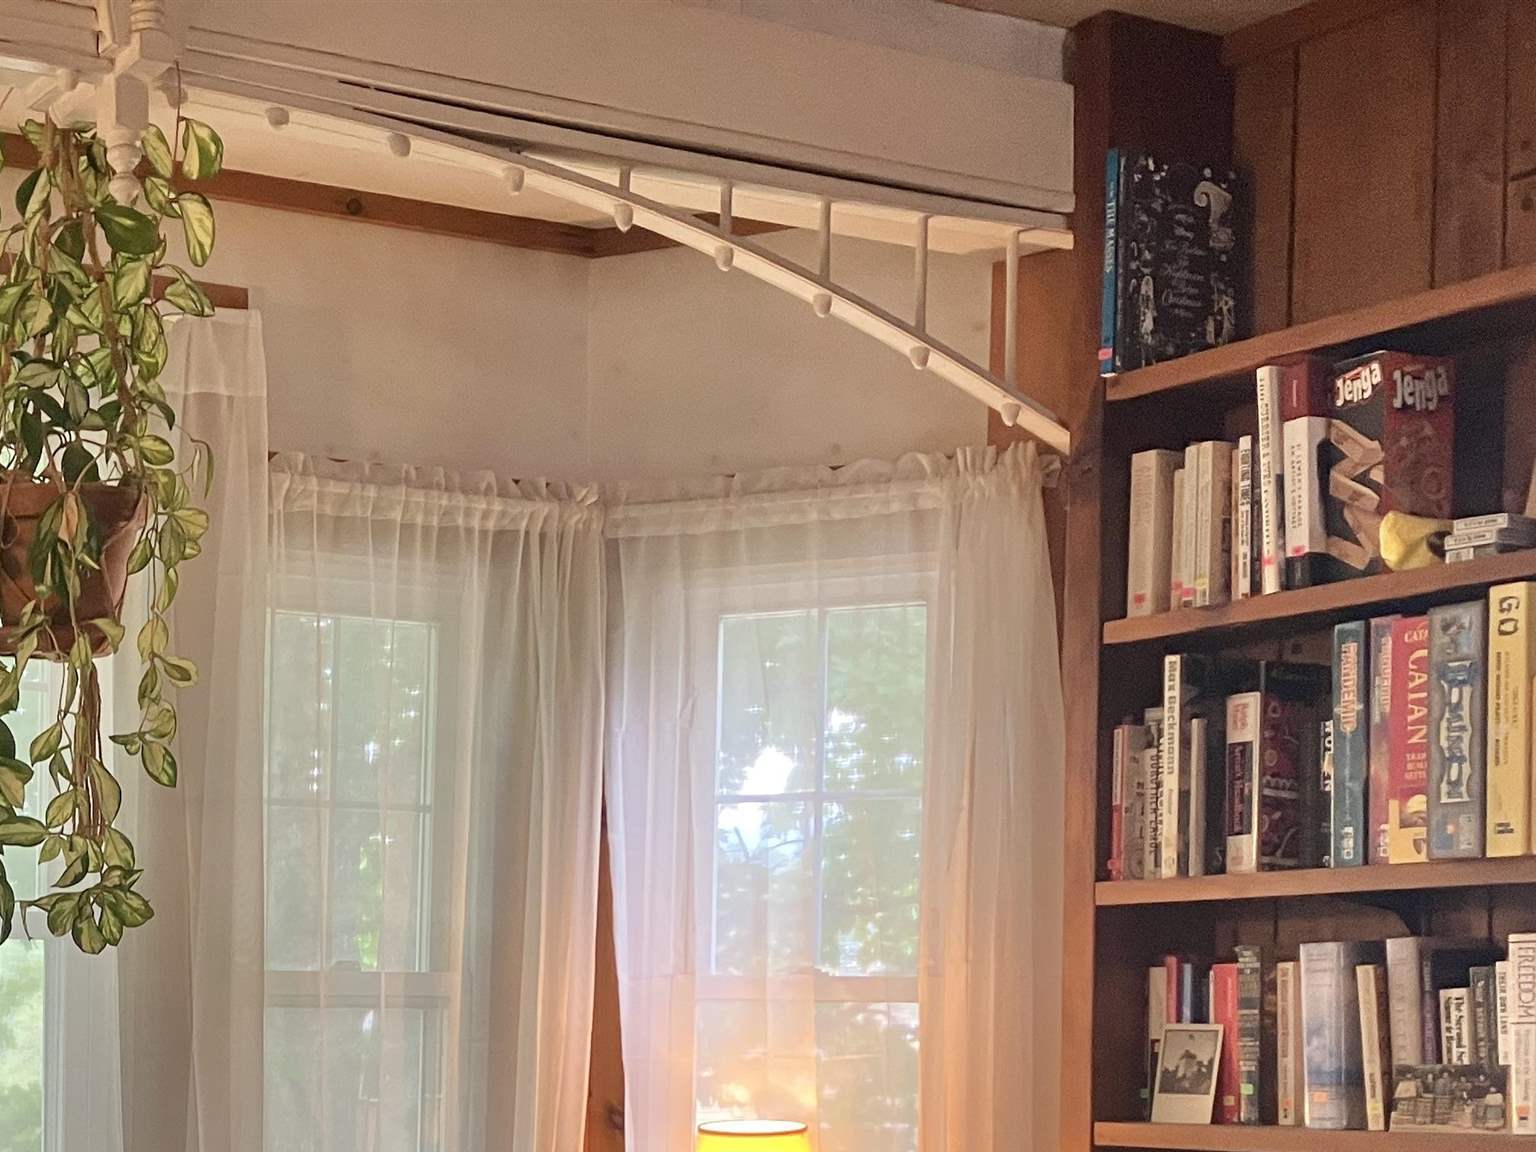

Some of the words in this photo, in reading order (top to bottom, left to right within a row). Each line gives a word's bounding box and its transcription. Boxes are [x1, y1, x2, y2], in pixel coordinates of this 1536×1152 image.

[1335, 362, 1382, 407] Jenga
[1392, 366, 1449, 411] Jenga
[1497, 594, 1521, 637] GO
[1167, 660, 1177, 692] Max
[1340, 641, 1358, 733] PANDEMIC
[1167, 695, 1177, 776] Beckmann
[1517, 946, 1536, 1019] FREEDOM
[1456, 1051, 1467, 1065] Se
